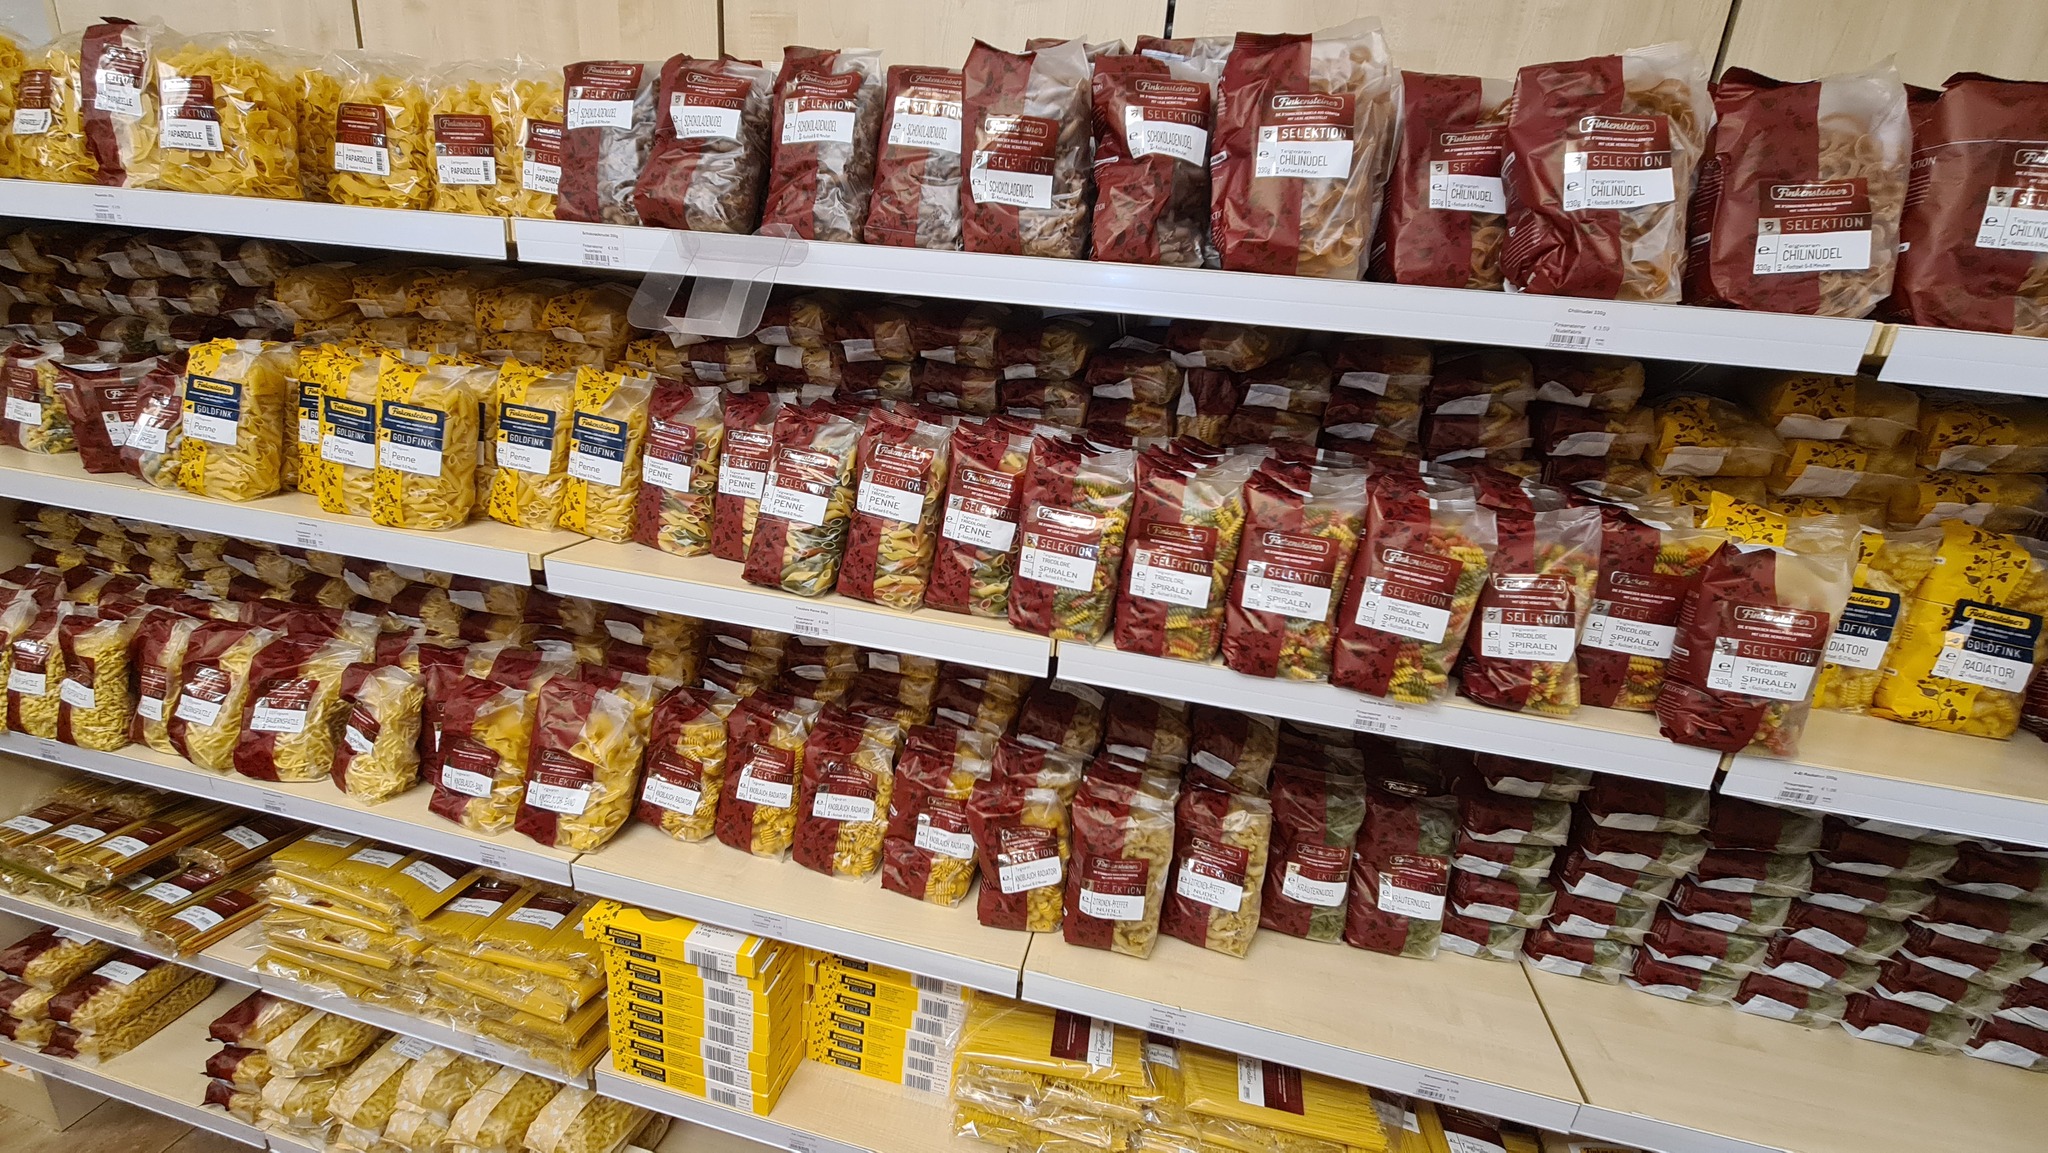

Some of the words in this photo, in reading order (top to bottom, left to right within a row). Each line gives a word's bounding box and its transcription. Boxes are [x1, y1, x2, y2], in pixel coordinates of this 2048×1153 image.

[585, 88, 632, 100] SELEKTION
[687, 96, 739, 108] SELEKTION
[801, 98, 851, 110] SELEKTION
[1278, 97, 1338, 108] Finkensteiner
[1146, 108, 1204, 125] SELEKTION
[906, 123, 948, 141] SCHOKOLADENUDEL
[1281, 127, 1347, 139] SELEKTION
[1586, 119, 1650, 133] Finkensteiner
[1146, 128, 1192, 150] SCHOKOLADENUDEL
[448, 145, 490, 156] SELEKTION
[1279, 154, 1328, 167] CHILINUDEL
[1592, 155, 1663, 168] SELEKTION
[450, 166, 481, 177] PAPARDELLE
[989, 181, 1035, 199] SCHOKOLADENUDEL
[1451, 188, 1493, 202] CHILINUDEL
[1590, 185, 1645, 197] CHILINUDEL
[1777, 186, 1847, 200] Finkensteiner
[1786, 216, 1863, 231] SELEKTION
[1782, 247, 1842, 262] CHILINUDEL
[197, 404, 233, 419] GOLDFINK
[391, 406, 434, 422] Finkensteiner
[508, 408, 546, 422] Finkensteiner
[194, 421, 217, 435] Penne
[580, 418, 616, 433] Finkensteiner
[336, 427, 366, 442] GOLDFINK
[392, 432, 434, 448] GOLDFINK
[509, 433, 544, 448] GOLDFINK
[333, 445, 354, 457] Penne
[391, 451, 416, 464] Penne
[509, 451, 531, 464] Penne
[580, 443, 616, 459] GOLDFINK
[651, 448, 688, 465] SELEKTION
[578, 460, 601, 475] Penne
[648, 468, 673, 481] PENNE
[728, 479, 756, 490] PENNE
[875, 473, 921, 492] SELEKTION
[773, 499, 805, 513] PENNE
[869, 496, 900, 511] PENNE
[959, 524, 993, 539] PENNE
[1039, 538, 1093, 558] SELEKTION
[1039, 565, 1078, 580] SPIRALEN
[1151, 555, 1208, 575] SELEKTION
[1268, 566, 1328, 586] SELEKTION
[1151, 581, 1193, 596] SPIRALEN
[1270, 585, 1304, 598] TRICOLORE
[1385, 584, 1447, 607] SELEKTION
[1266, 594, 1311, 610] SPIRALEN
[1387, 603, 1422, 618] TRICOLORE
[1967, 607, 2025, 627] Finkensteiner
[1383, 612, 1430, 630] SPIRALEN
[1505, 611, 1569, 626] SELEKTION
[1511, 631, 1547, 641] TRICOLORE
[1615, 624, 1652, 637] TRICOLORE
[1508, 640, 1558, 651] SPIRALEN
[1610, 633, 1660, 648] SPIRALEN
[1742, 643, 1814, 664] SELEKTION
[1966, 638, 2021, 659] GOLDFINK
[1746, 664, 1788, 677] TRICOLORE
[1961, 658, 2016, 679] RADIATORI
[1741, 674, 1796, 690] SPIRALEN
